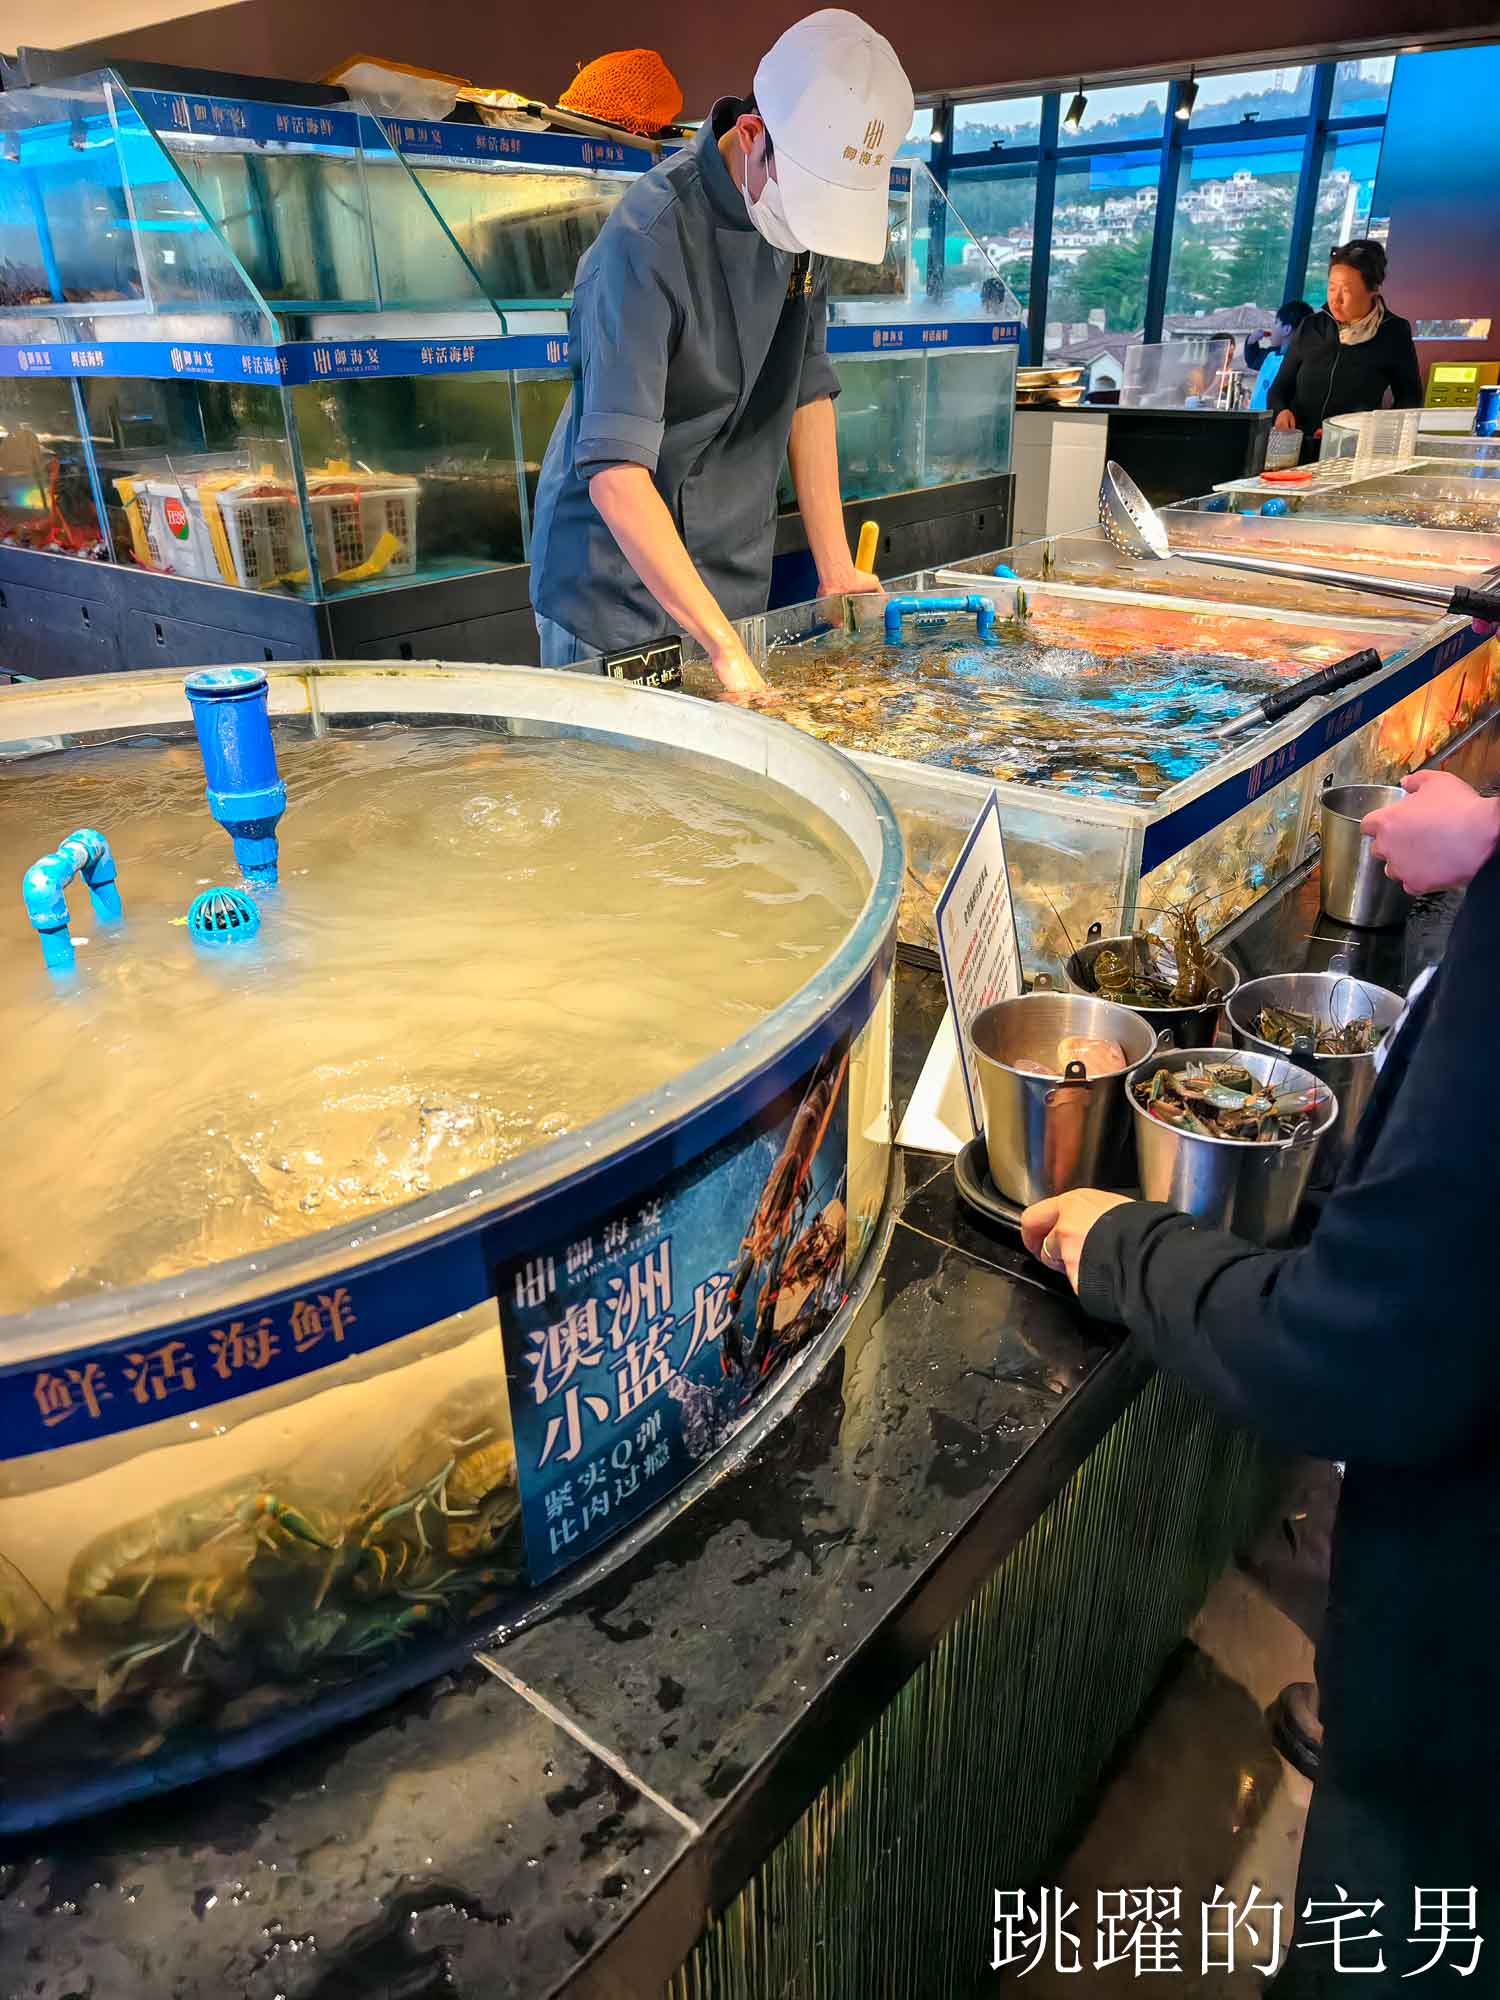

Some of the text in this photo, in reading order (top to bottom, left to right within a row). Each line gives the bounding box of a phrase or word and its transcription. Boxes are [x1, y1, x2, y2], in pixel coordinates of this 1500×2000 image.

[421, 346, 475, 364] 鲜活海鲜
[34, 1287, 358, 1427] 鲜活海鲜
[526, 1241, 673, 1404] 澳洲
[537, 1273, 735, 1470] 小蓝龙
